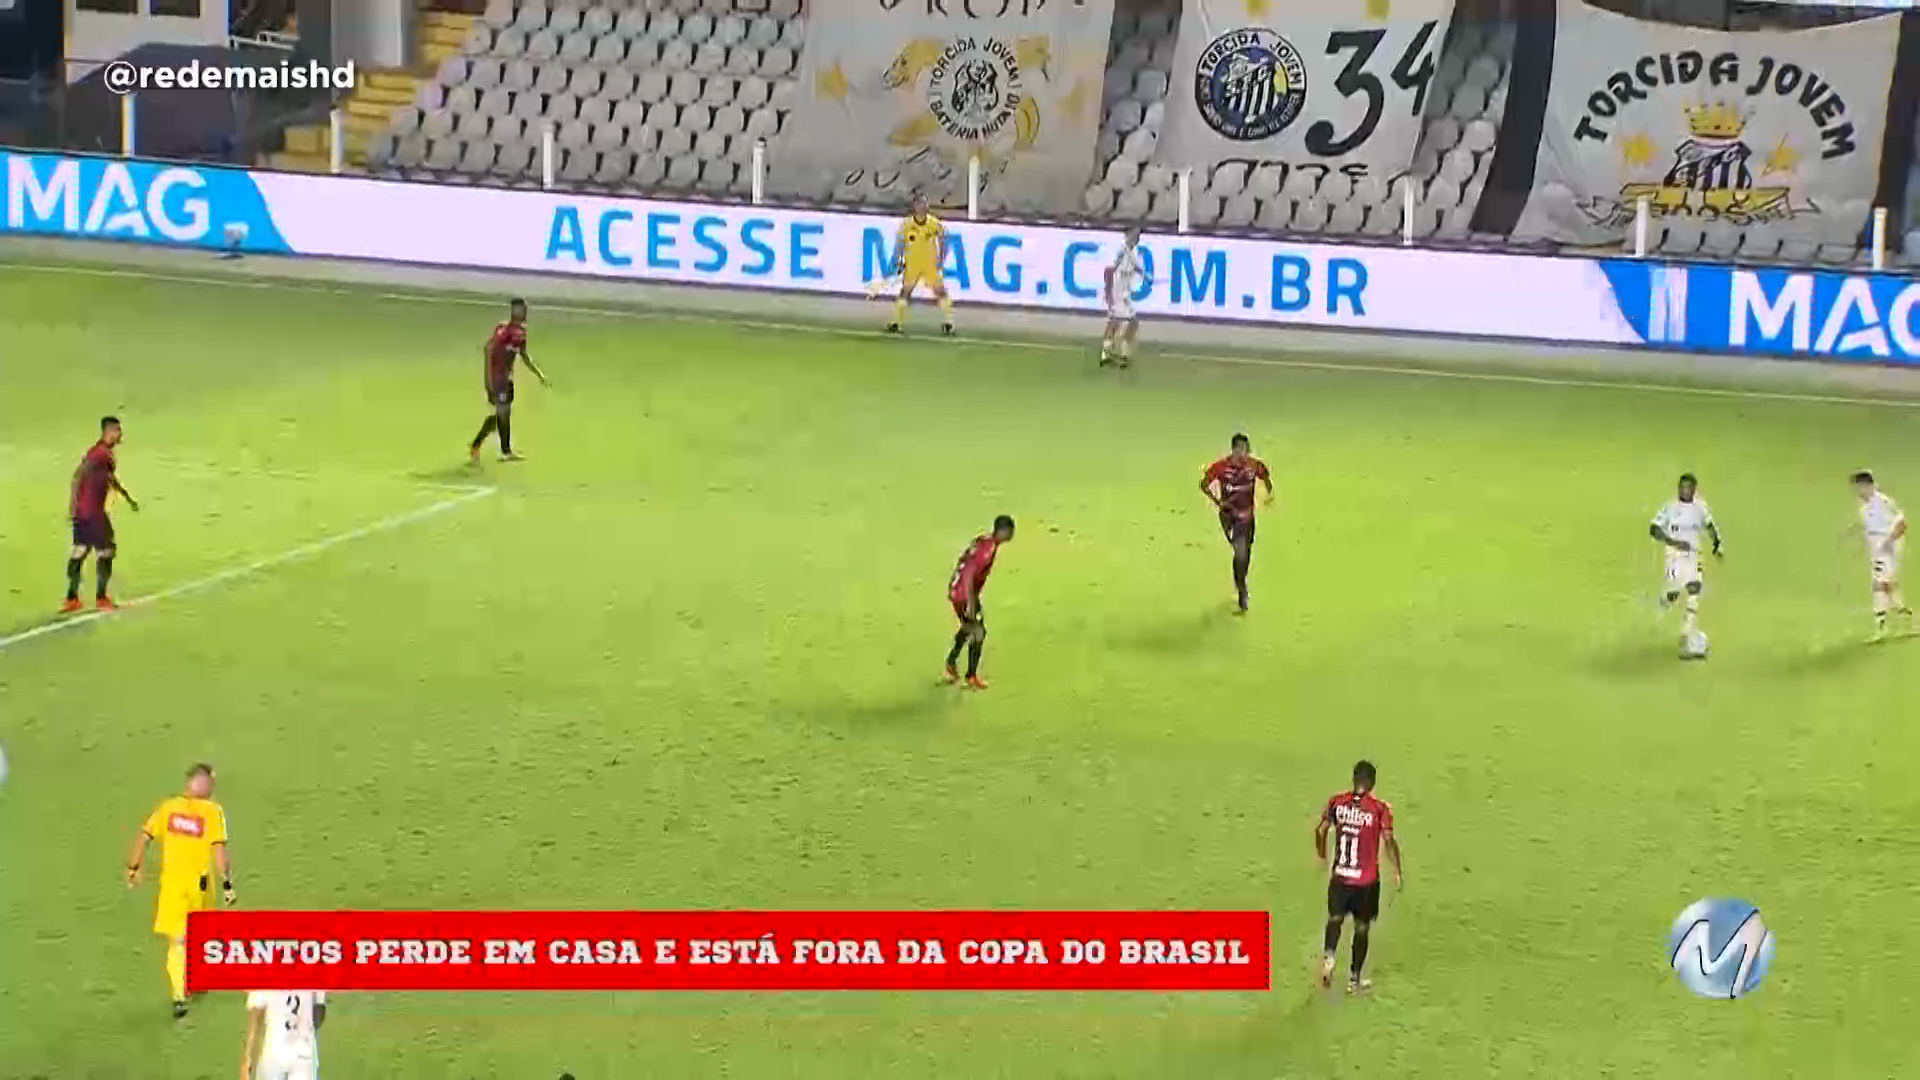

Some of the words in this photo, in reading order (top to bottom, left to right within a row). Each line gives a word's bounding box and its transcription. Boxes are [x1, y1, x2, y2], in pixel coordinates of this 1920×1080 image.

[930, 37, 977, 88] TORCIDA
[983, 37, 1019, 81] JOVEM
[1201, 32, 1261, 72] TORCIDA
[1268, 41, 1303, 84] JOVEM
[1304, 19, 1438, 156] 34
[1574, 50, 1740, 143] TORCIDA
[1745, 57, 1856, 160] JOVEM
[6, 155, 211, 241] MAG
[544, 205, 826, 280] ACESSE
[1339, 834, 1359, 867] 11
